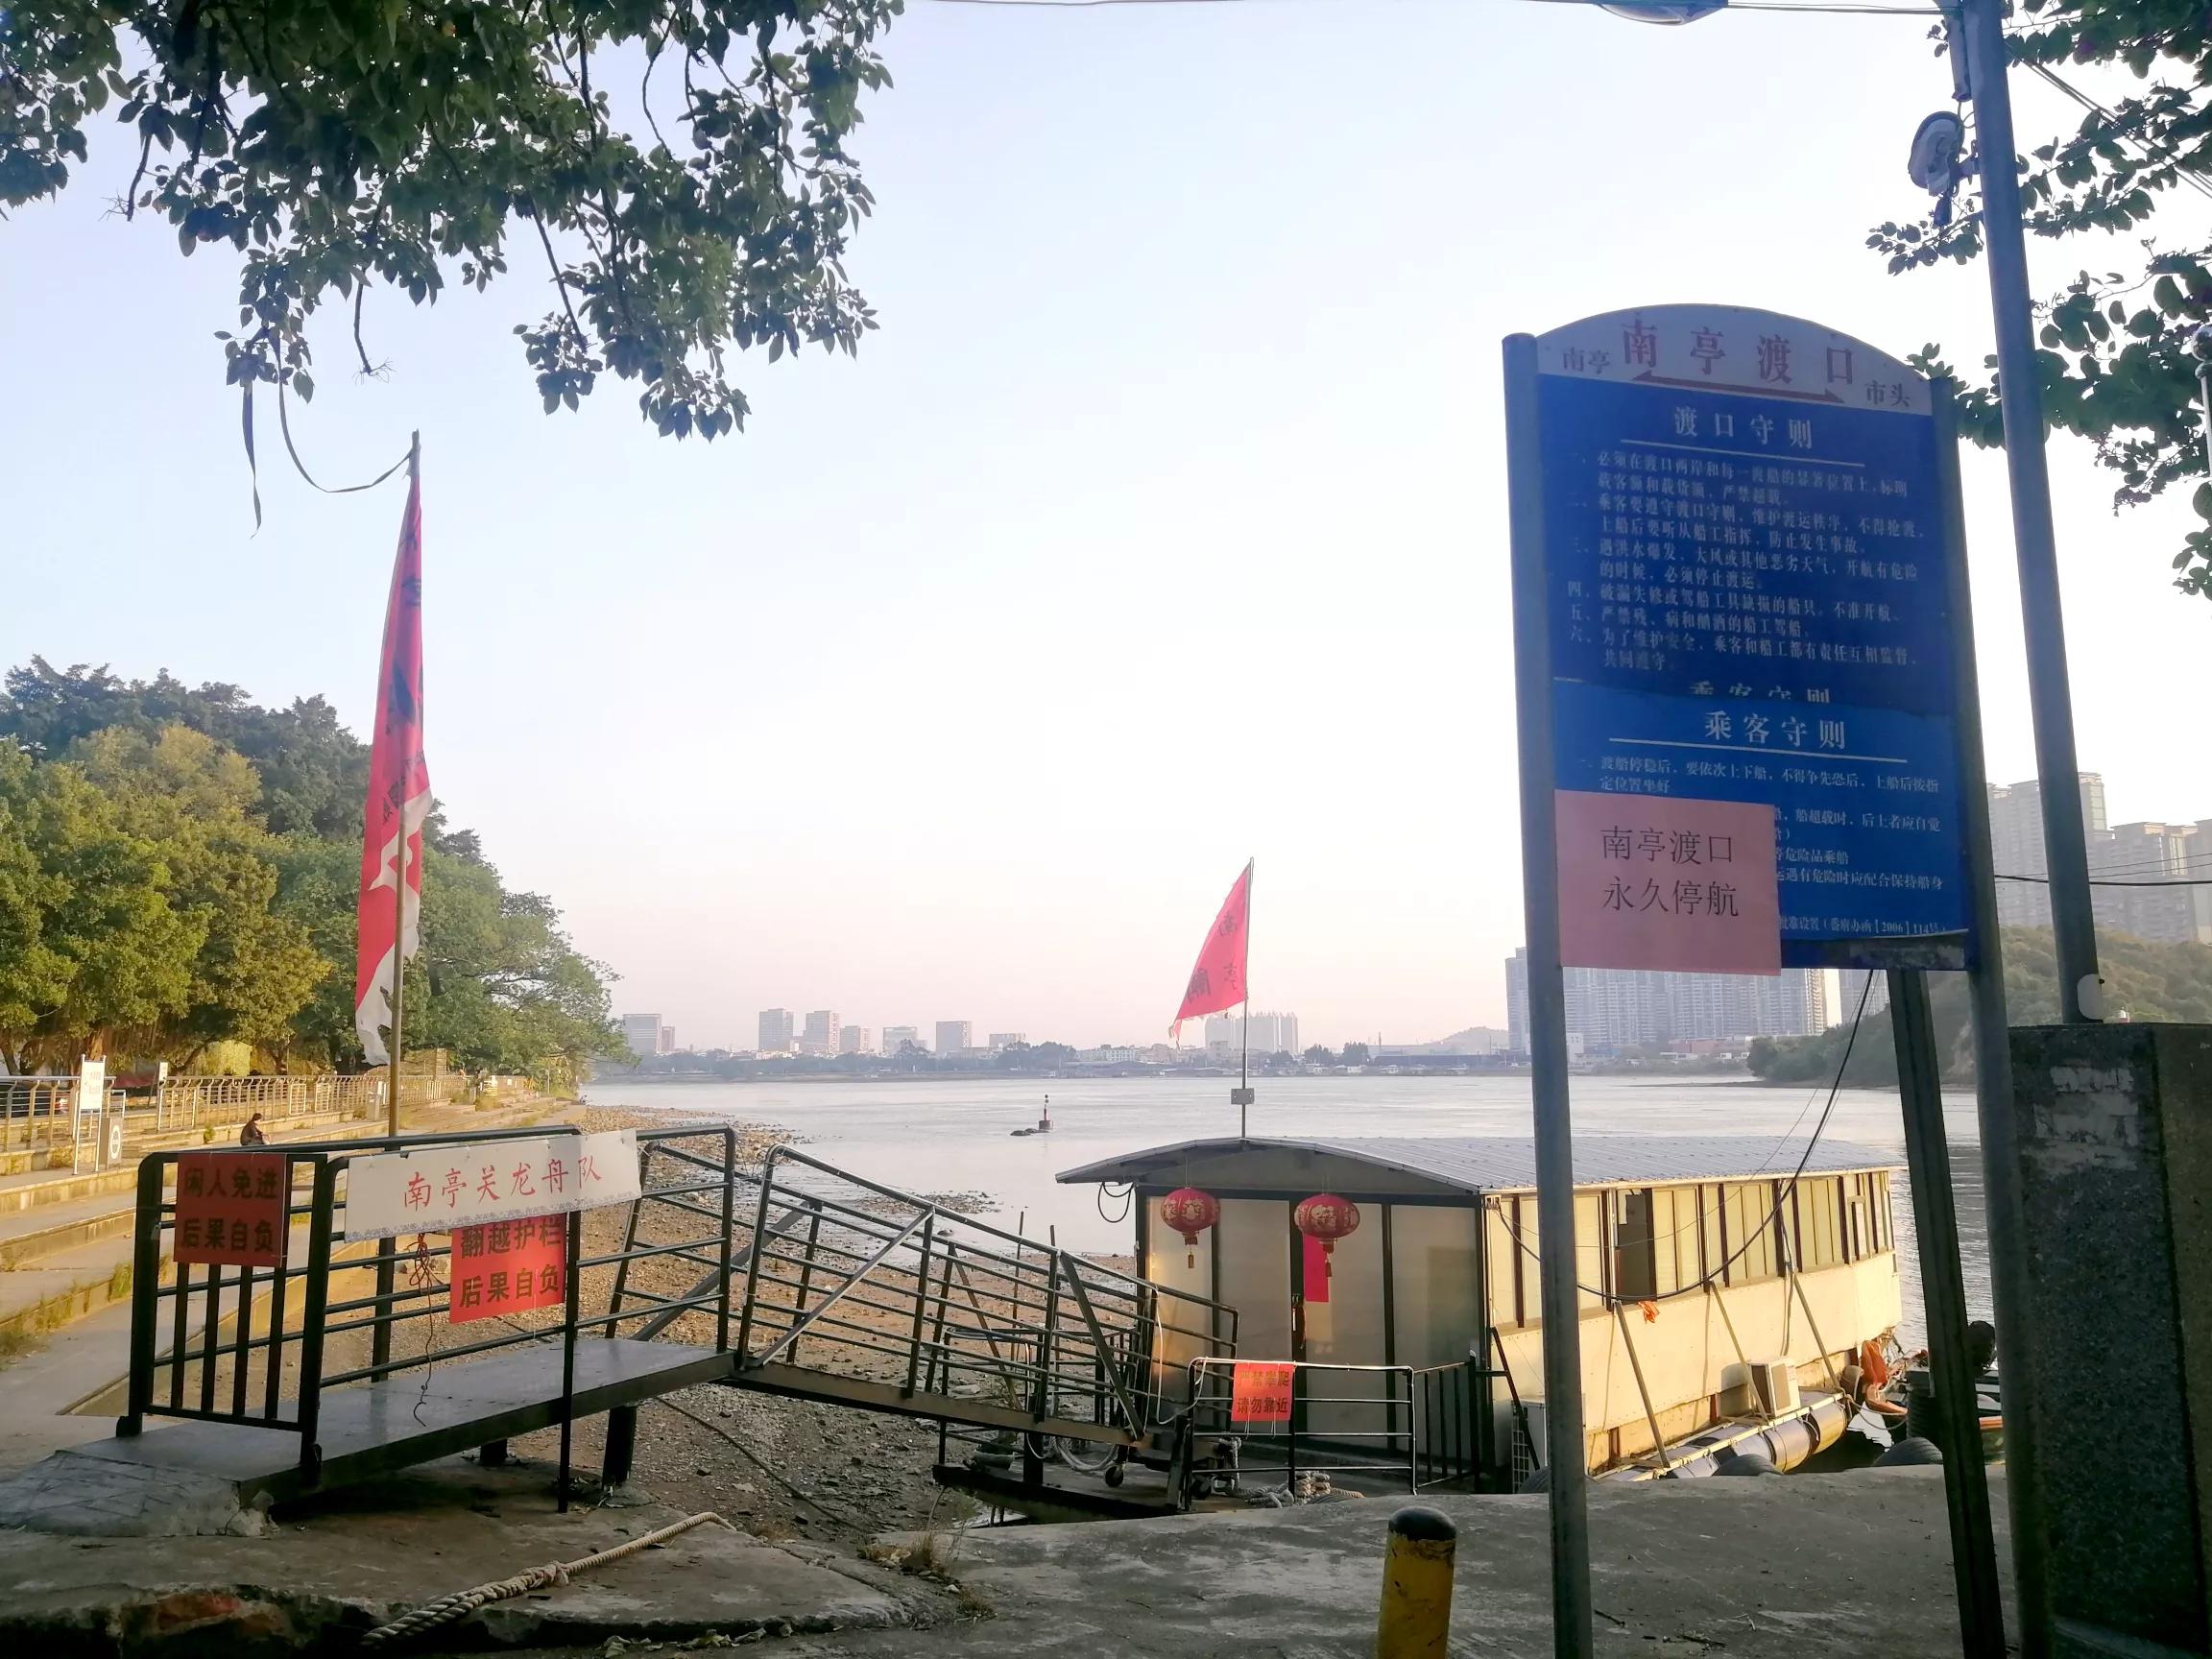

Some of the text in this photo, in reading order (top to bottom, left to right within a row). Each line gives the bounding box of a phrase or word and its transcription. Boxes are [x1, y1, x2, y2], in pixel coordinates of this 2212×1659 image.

[1563, 347, 1611, 374] 南亭
[1621, 320, 1853, 384] 南亭渡口
[1865, 379, 1911, 408] 市头
[1673, 405, 1812, 449] 渡口守则
[1704, 710, 1845, 749] 乘客守则
[1599, 776, 1671, 794] 定位置坐好
[1600, 826, 1733, 864] 南亭渡口
[1602, 876, 1739, 916] 永久停航
[183, 1167, 277, 1199] 闲人免进
[403, 1155, 602, 1212] 南亭关龙舟队
[180, 1217, 274, 1252] 后果自负
[461, 1216, 561, 1259] 翻越护栏
[459, 1263, 559, 1308] 后果自负
[1238, 1370, 1290, 1387] 严禁攀爬
[1237, 1397, 1288, 1414] 请勿靠近
